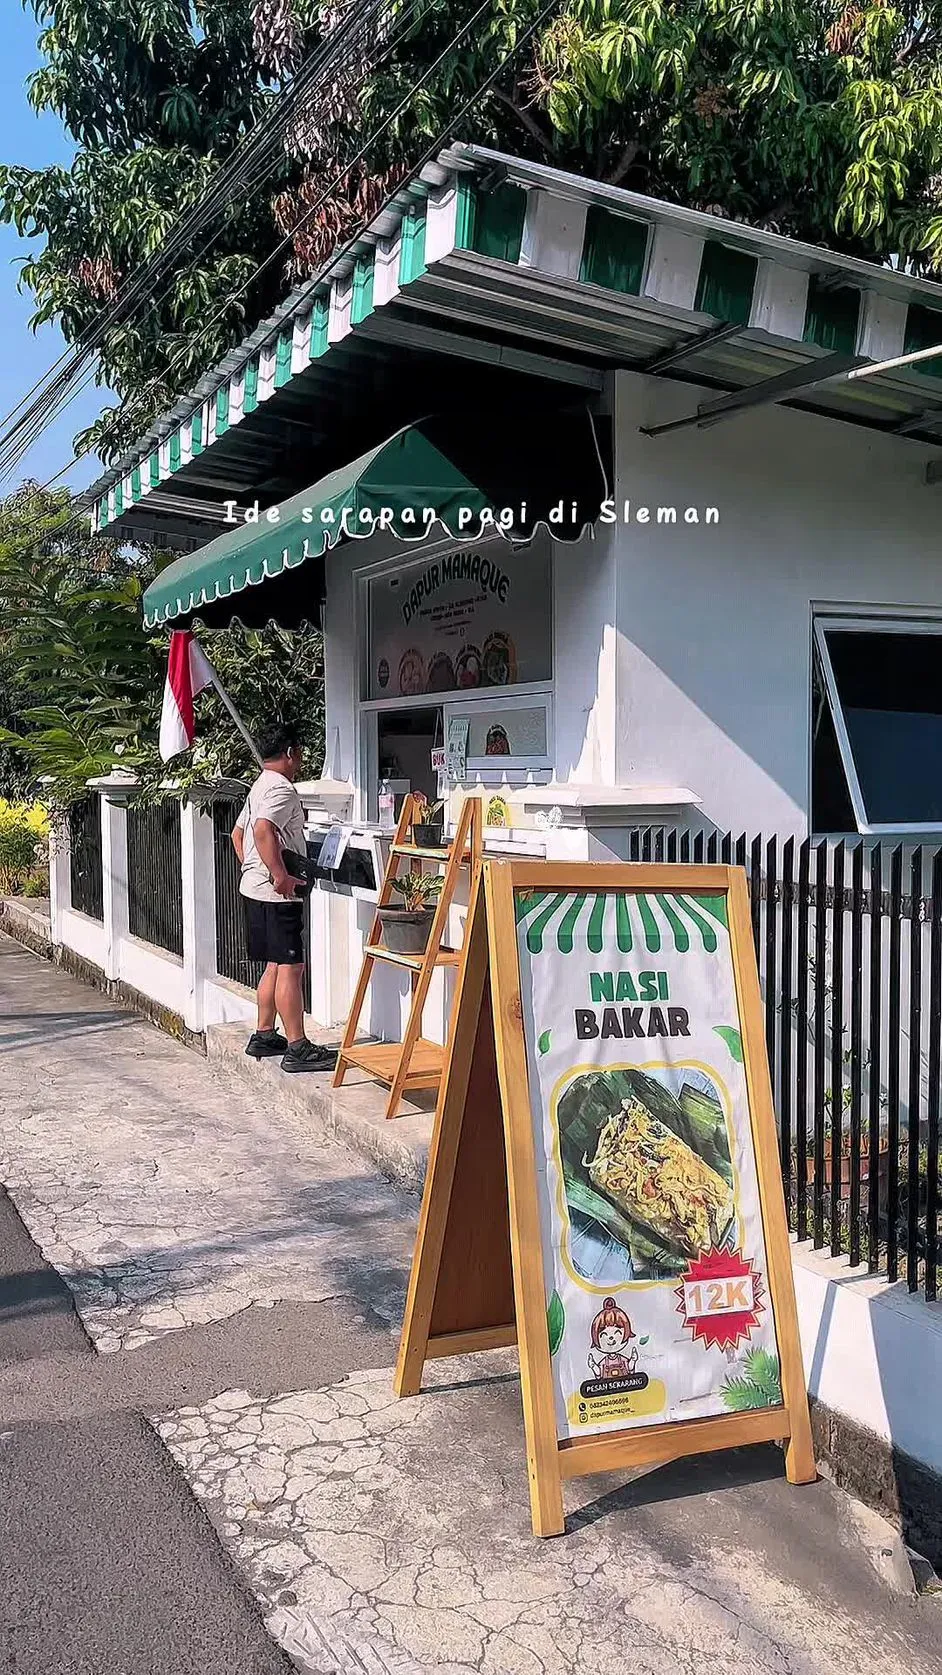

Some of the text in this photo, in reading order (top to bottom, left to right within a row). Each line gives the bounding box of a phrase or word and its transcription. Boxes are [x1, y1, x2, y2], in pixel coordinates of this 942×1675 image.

[402, 553, 511, 627] DAPUR MAMAQUE
[589, 970, 670, 1003] NASI
[574, 1006, 692, 1040] BAKAR
[688, 1280, 749, 1312] 12K
[586, 1377, 643, 1393] PESAN SEKARANG
